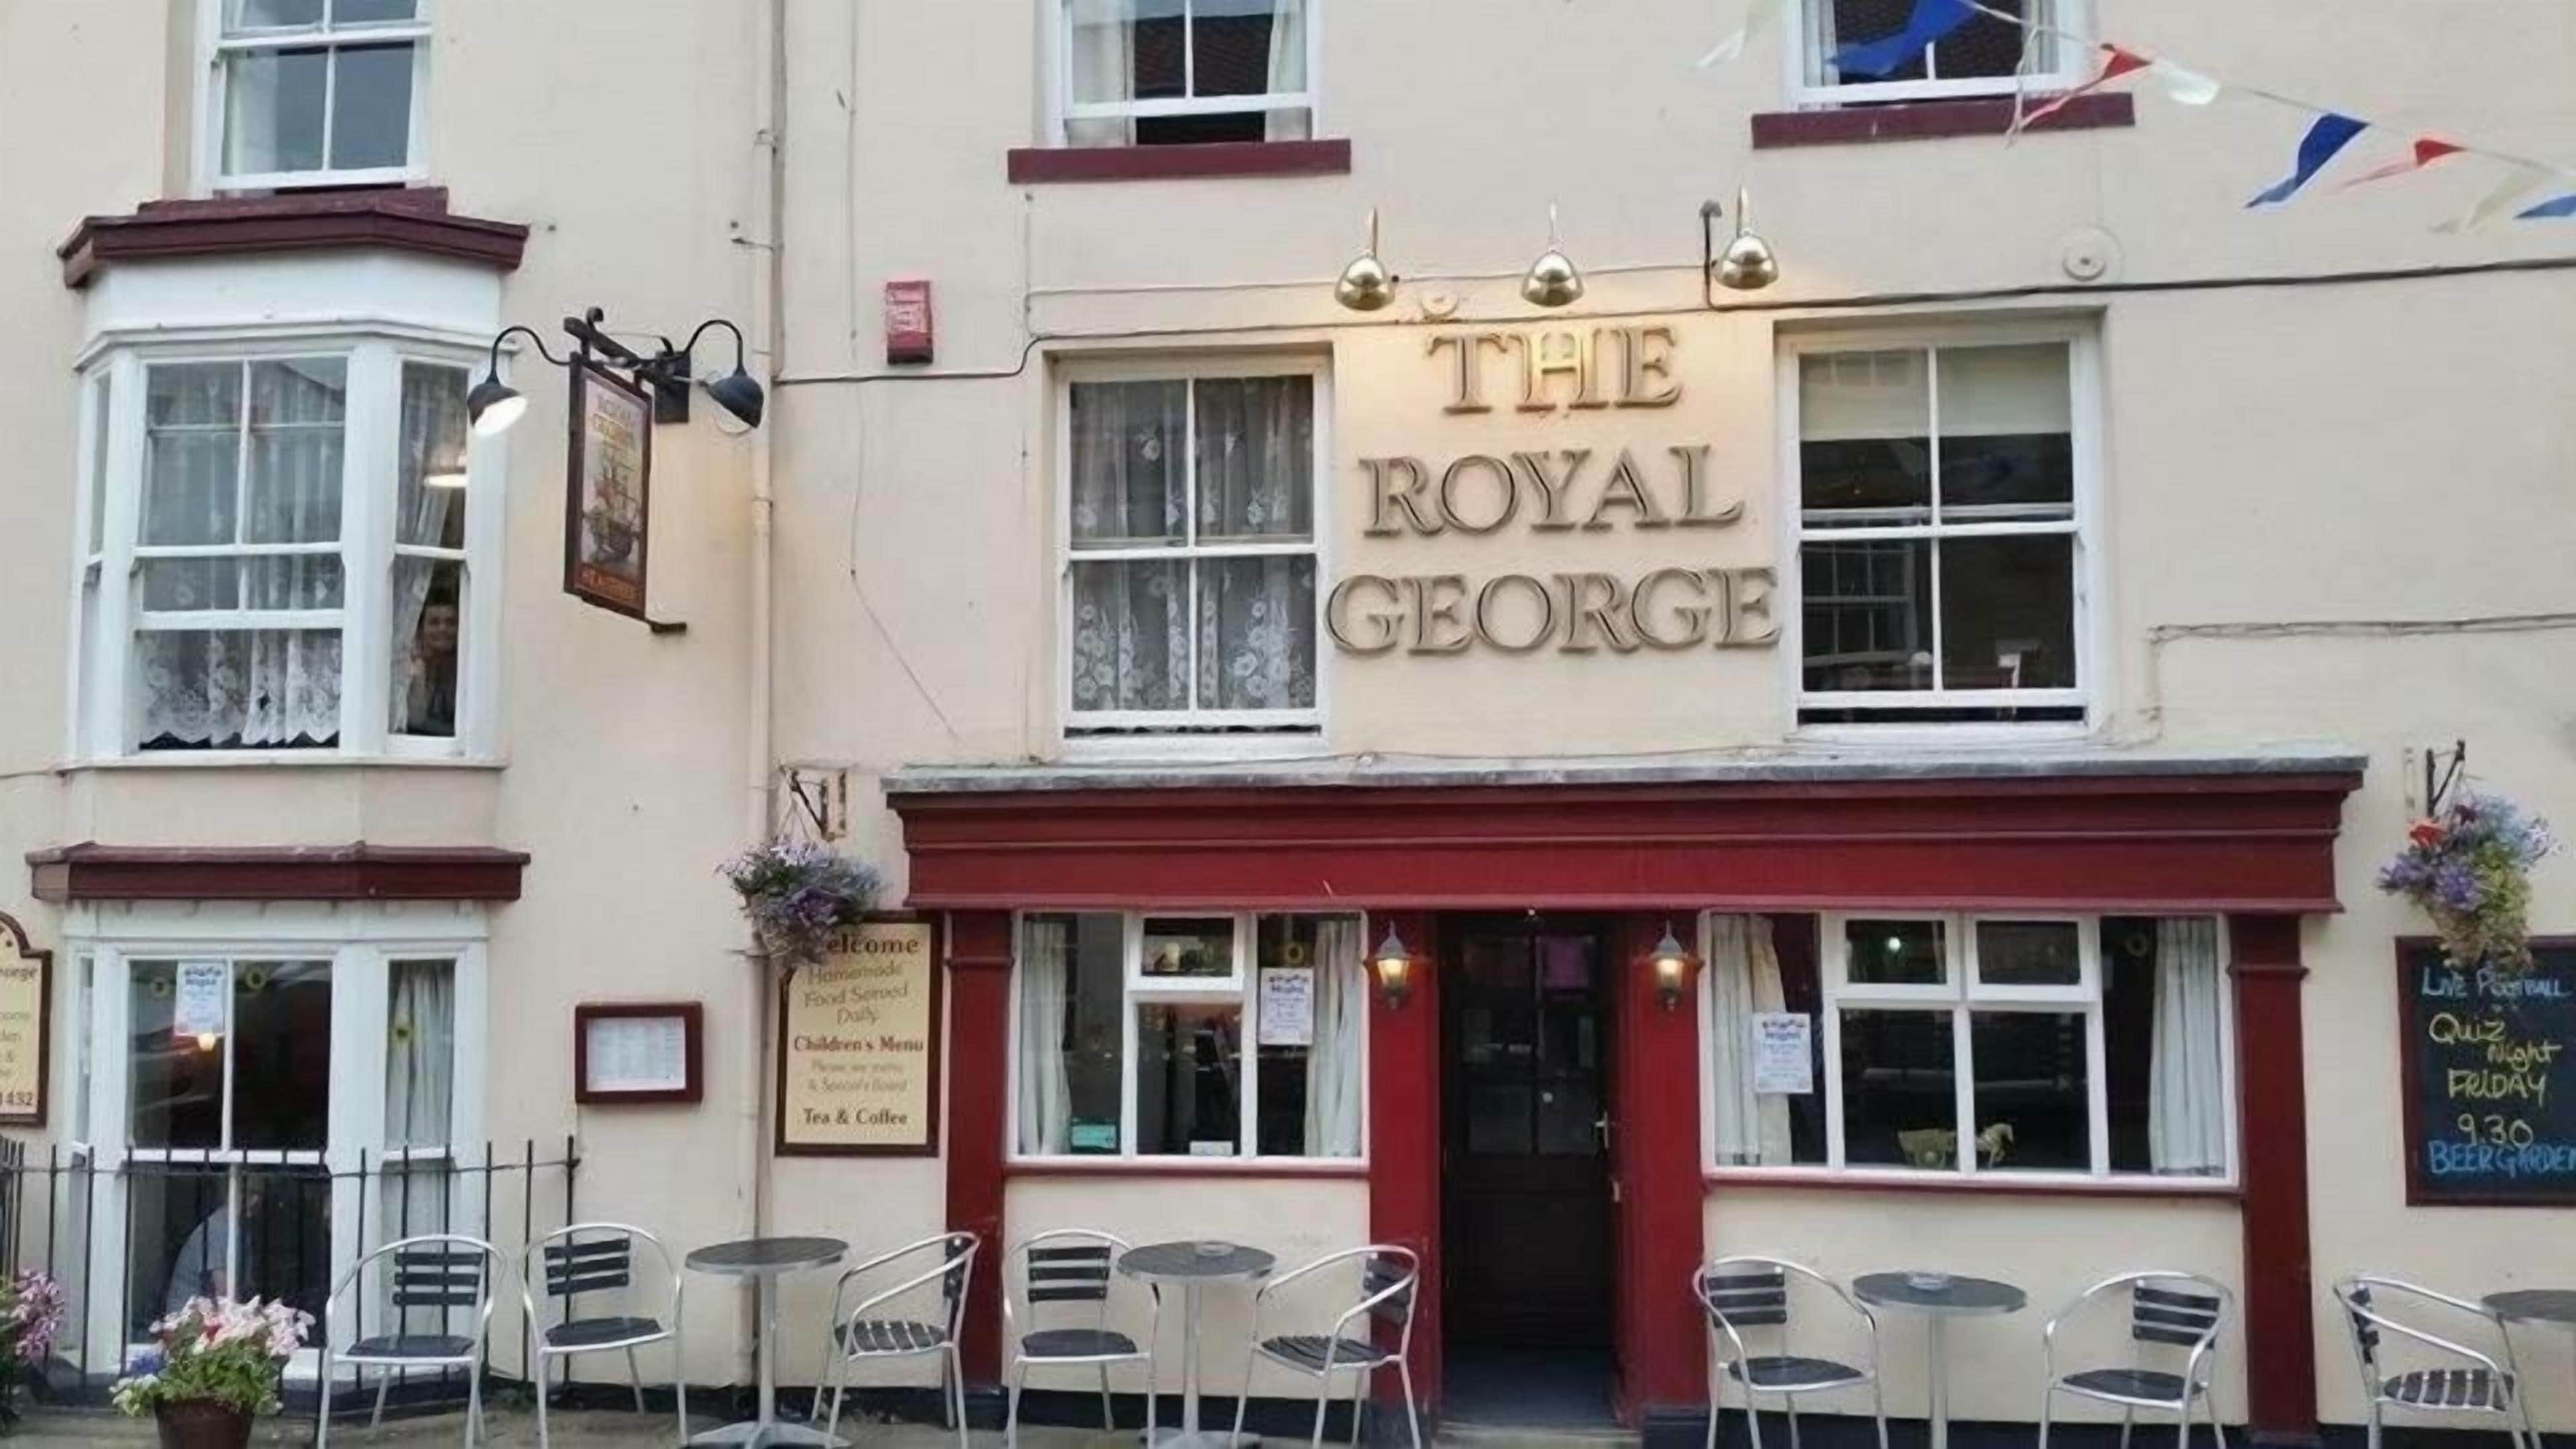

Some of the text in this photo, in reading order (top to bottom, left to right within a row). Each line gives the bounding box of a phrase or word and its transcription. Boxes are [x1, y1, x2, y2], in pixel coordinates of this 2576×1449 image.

[1426, 326, 1682, 414] THE
[1358, 444, 1743, 537] ROYAL
[1324, 566, 1782, 655] GEORGE
[826, 933, 919, 955] elcome
[805, 987, 847, 1008] Food
[880, 1036, 924, 1052] Menu
[804, 1108, 908, 1124] Tea & Coffee
